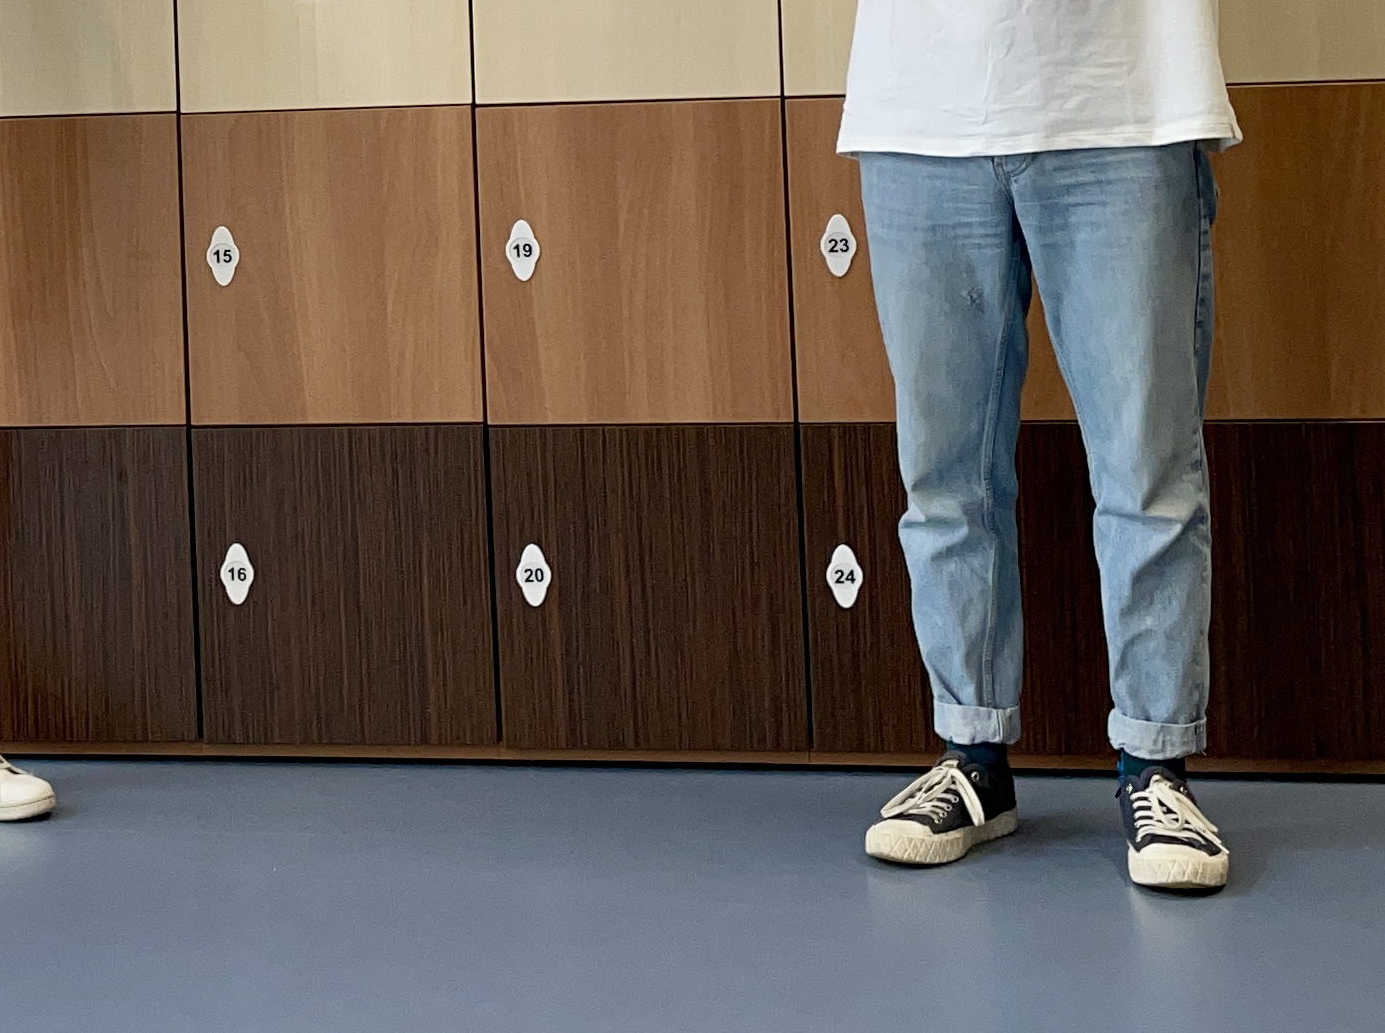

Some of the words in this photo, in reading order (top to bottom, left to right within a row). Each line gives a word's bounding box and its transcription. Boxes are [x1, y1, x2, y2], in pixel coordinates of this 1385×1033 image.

[512, 244, 532, 258] 19
[828, 238, 850, 253] 23
[213, 249, 232, 264] 15
[228, 568, 247, 582] 16
[523, 568, 544, 583] 20
[834, 570, 856, 584] 24
